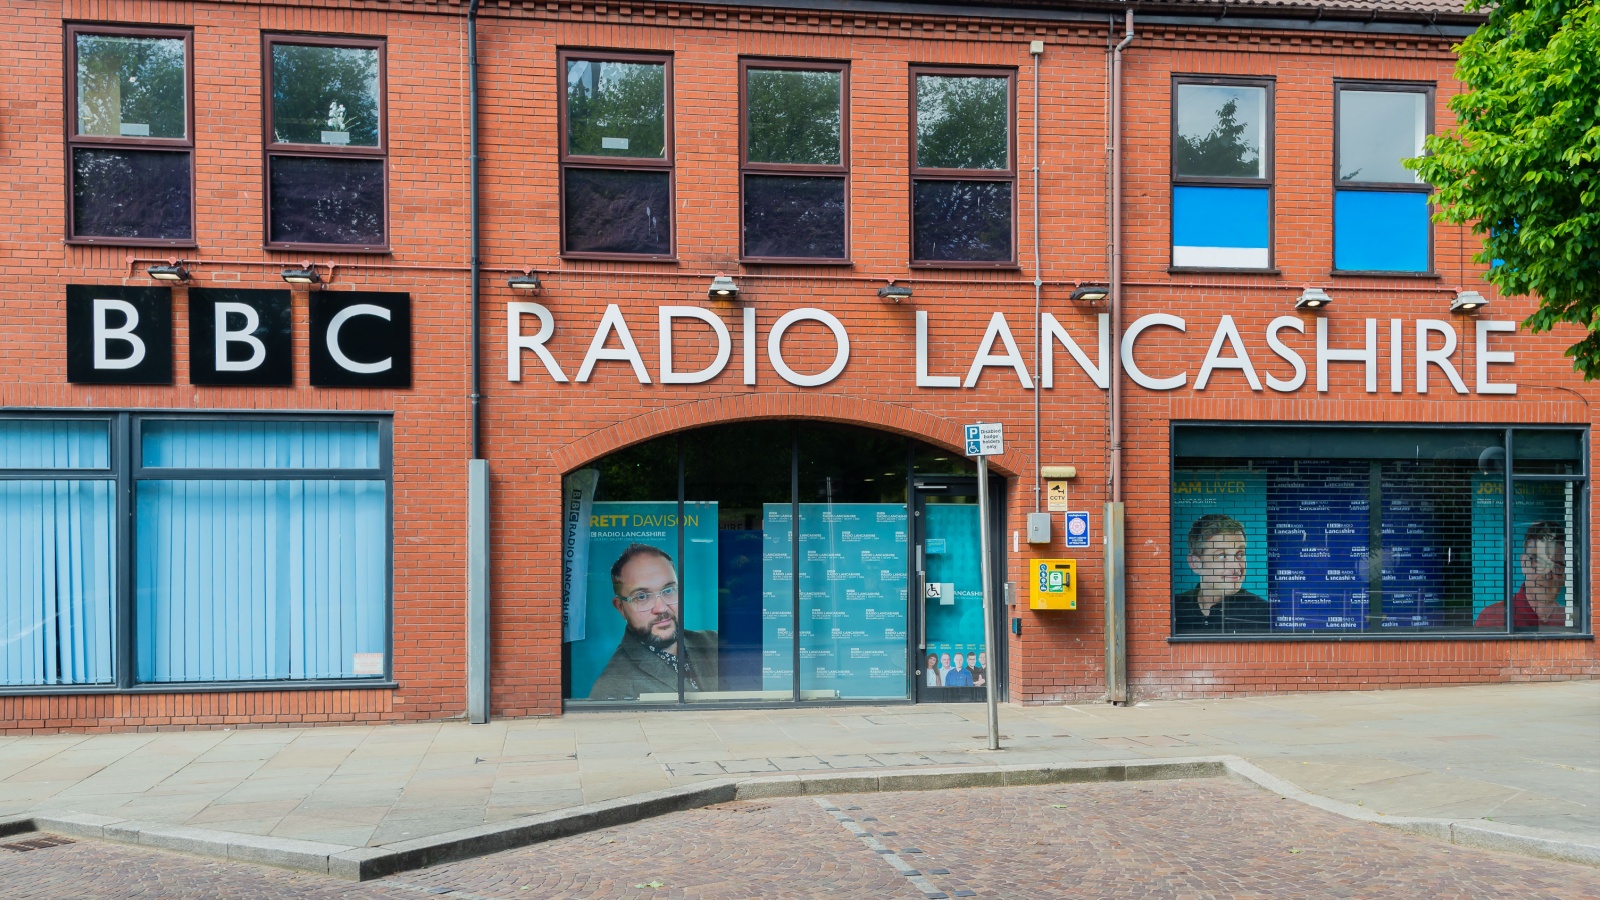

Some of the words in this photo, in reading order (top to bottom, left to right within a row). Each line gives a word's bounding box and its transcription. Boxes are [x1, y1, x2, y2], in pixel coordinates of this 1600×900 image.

[93, 299, 392, 374] BBC
[507, 301, 850, 386] RADIO
[915, 310, 1516, 395] LANCASHIRE
[970, 428, 978, 438] P
[1206, 482, 1245, 493] LIVER
[590, 514, 629, 527] RETT
[566, 523, 577, 558] RADIO
